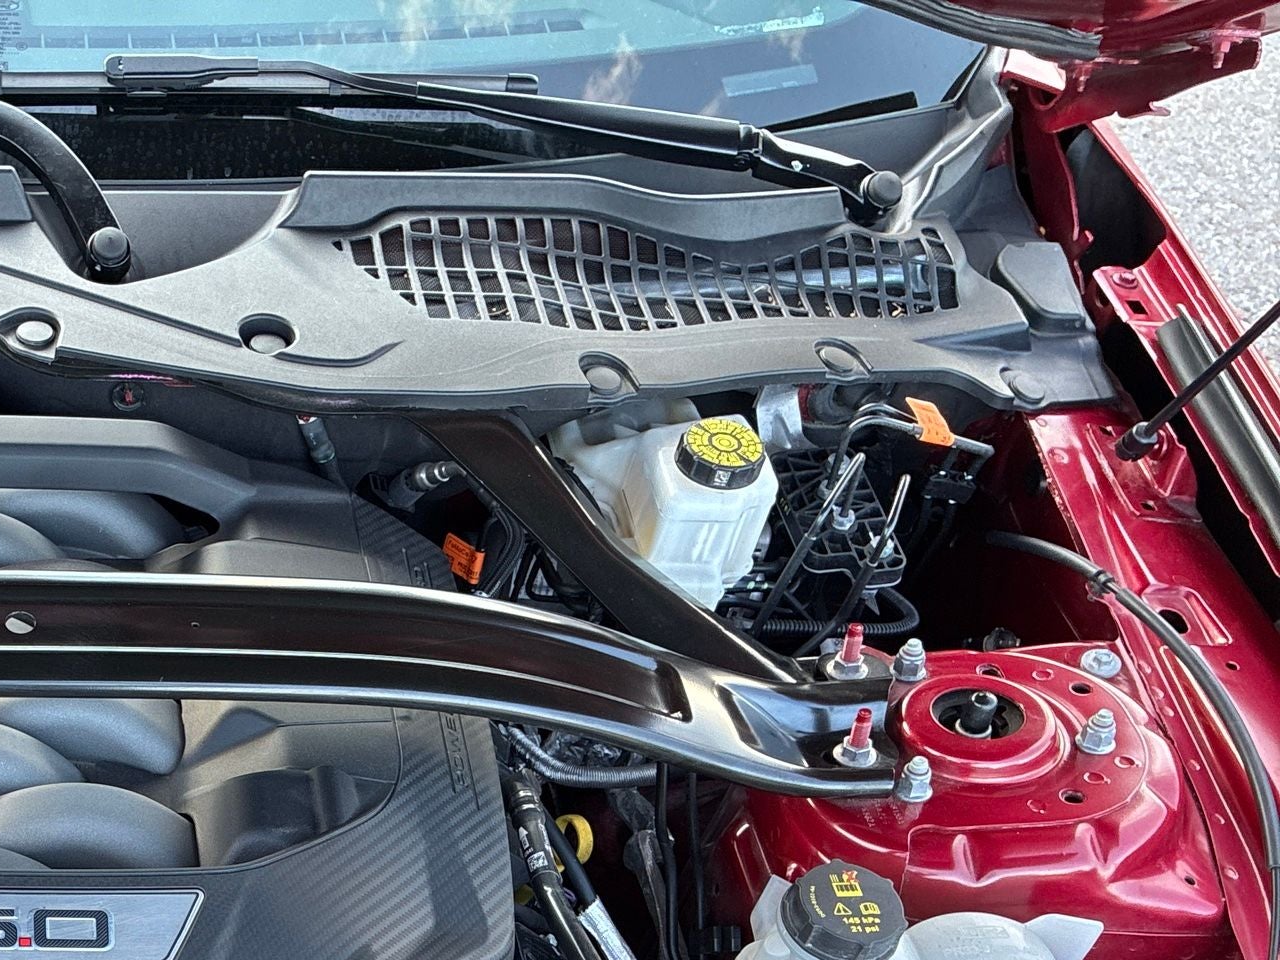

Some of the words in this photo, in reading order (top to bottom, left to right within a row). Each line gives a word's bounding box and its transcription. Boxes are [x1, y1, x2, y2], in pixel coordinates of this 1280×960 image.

[445, 713, 469, 789] POWE
[861, 916, 881, 924] kPa
[850, 925, 863, 933] 21
[864, 925, 880, 934] psi
